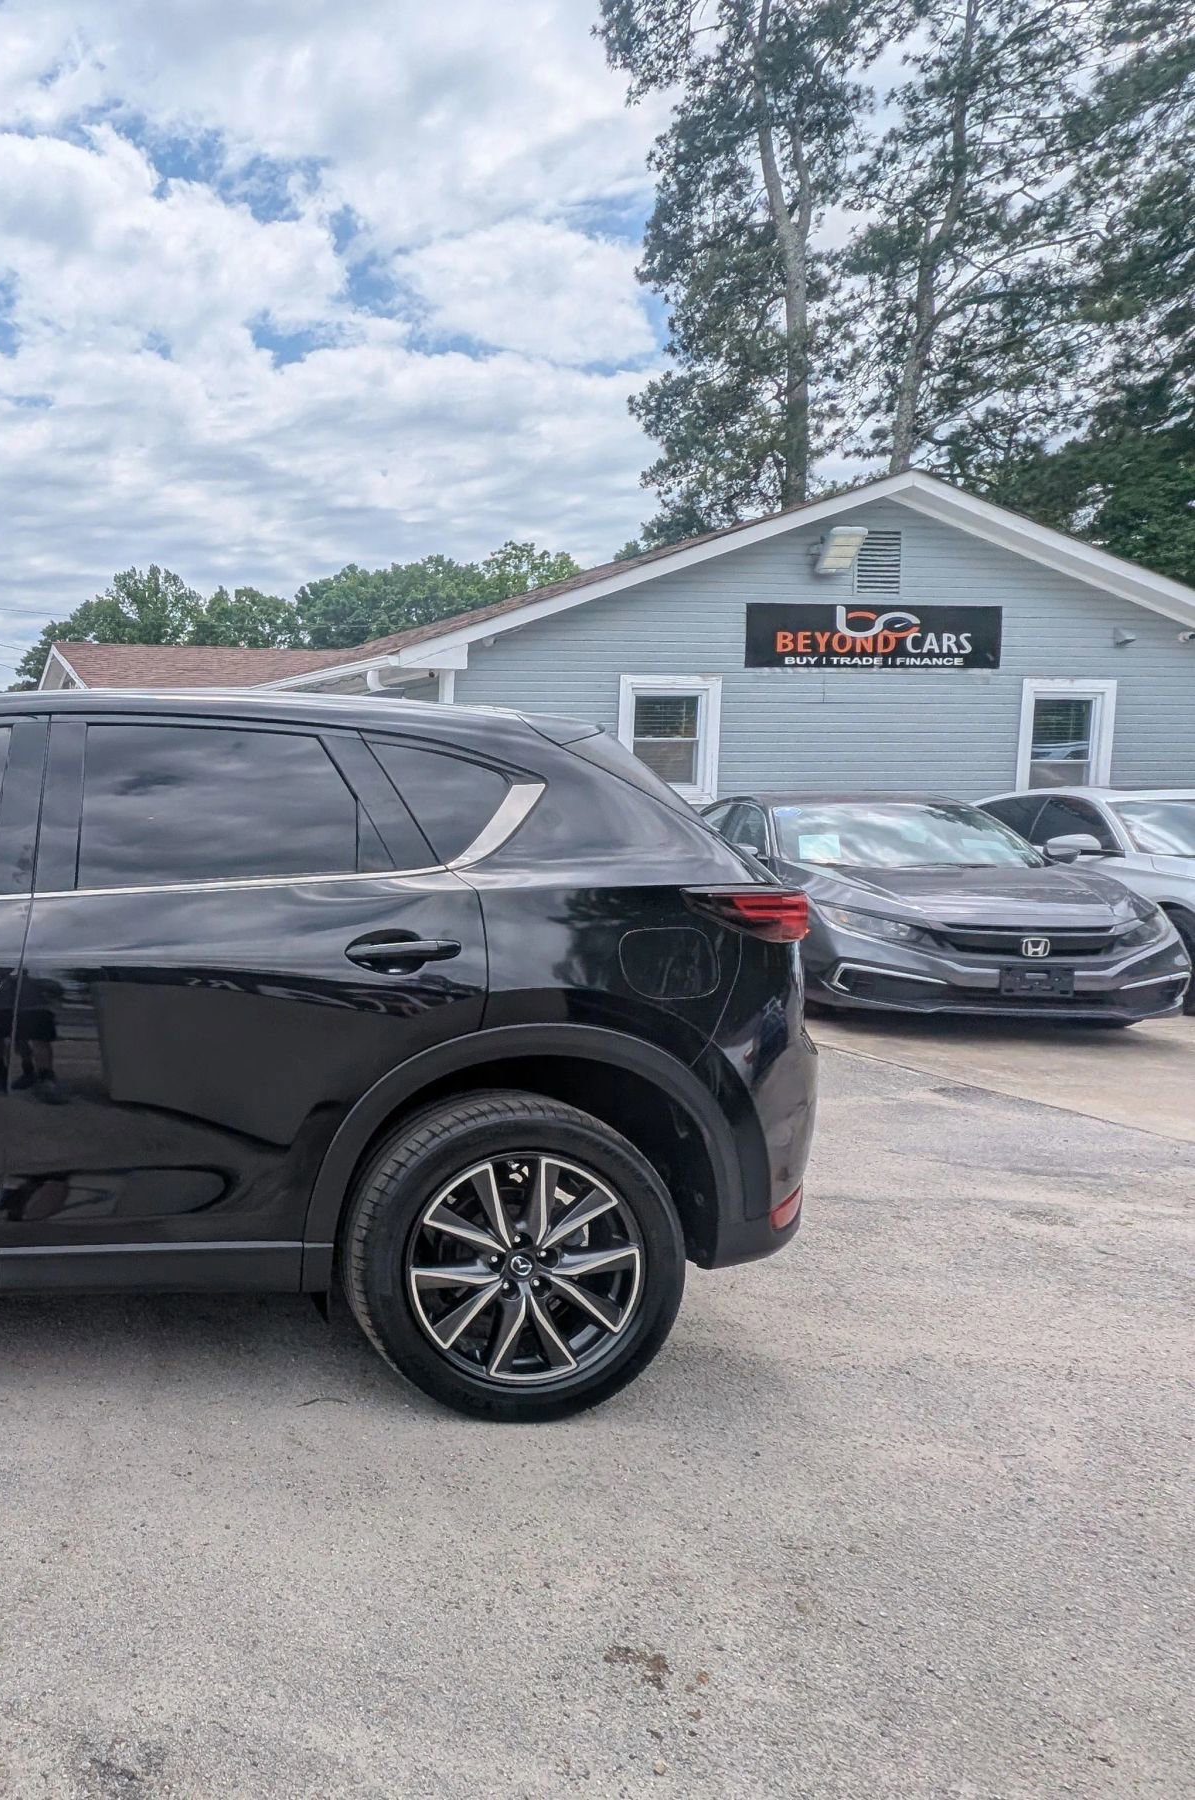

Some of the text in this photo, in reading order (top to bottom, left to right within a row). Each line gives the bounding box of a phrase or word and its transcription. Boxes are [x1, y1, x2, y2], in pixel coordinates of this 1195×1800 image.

[776, 631, 973, 655] BEYOND CARS
[784, 656, 964, 667] BUY TRADE FINANCE
